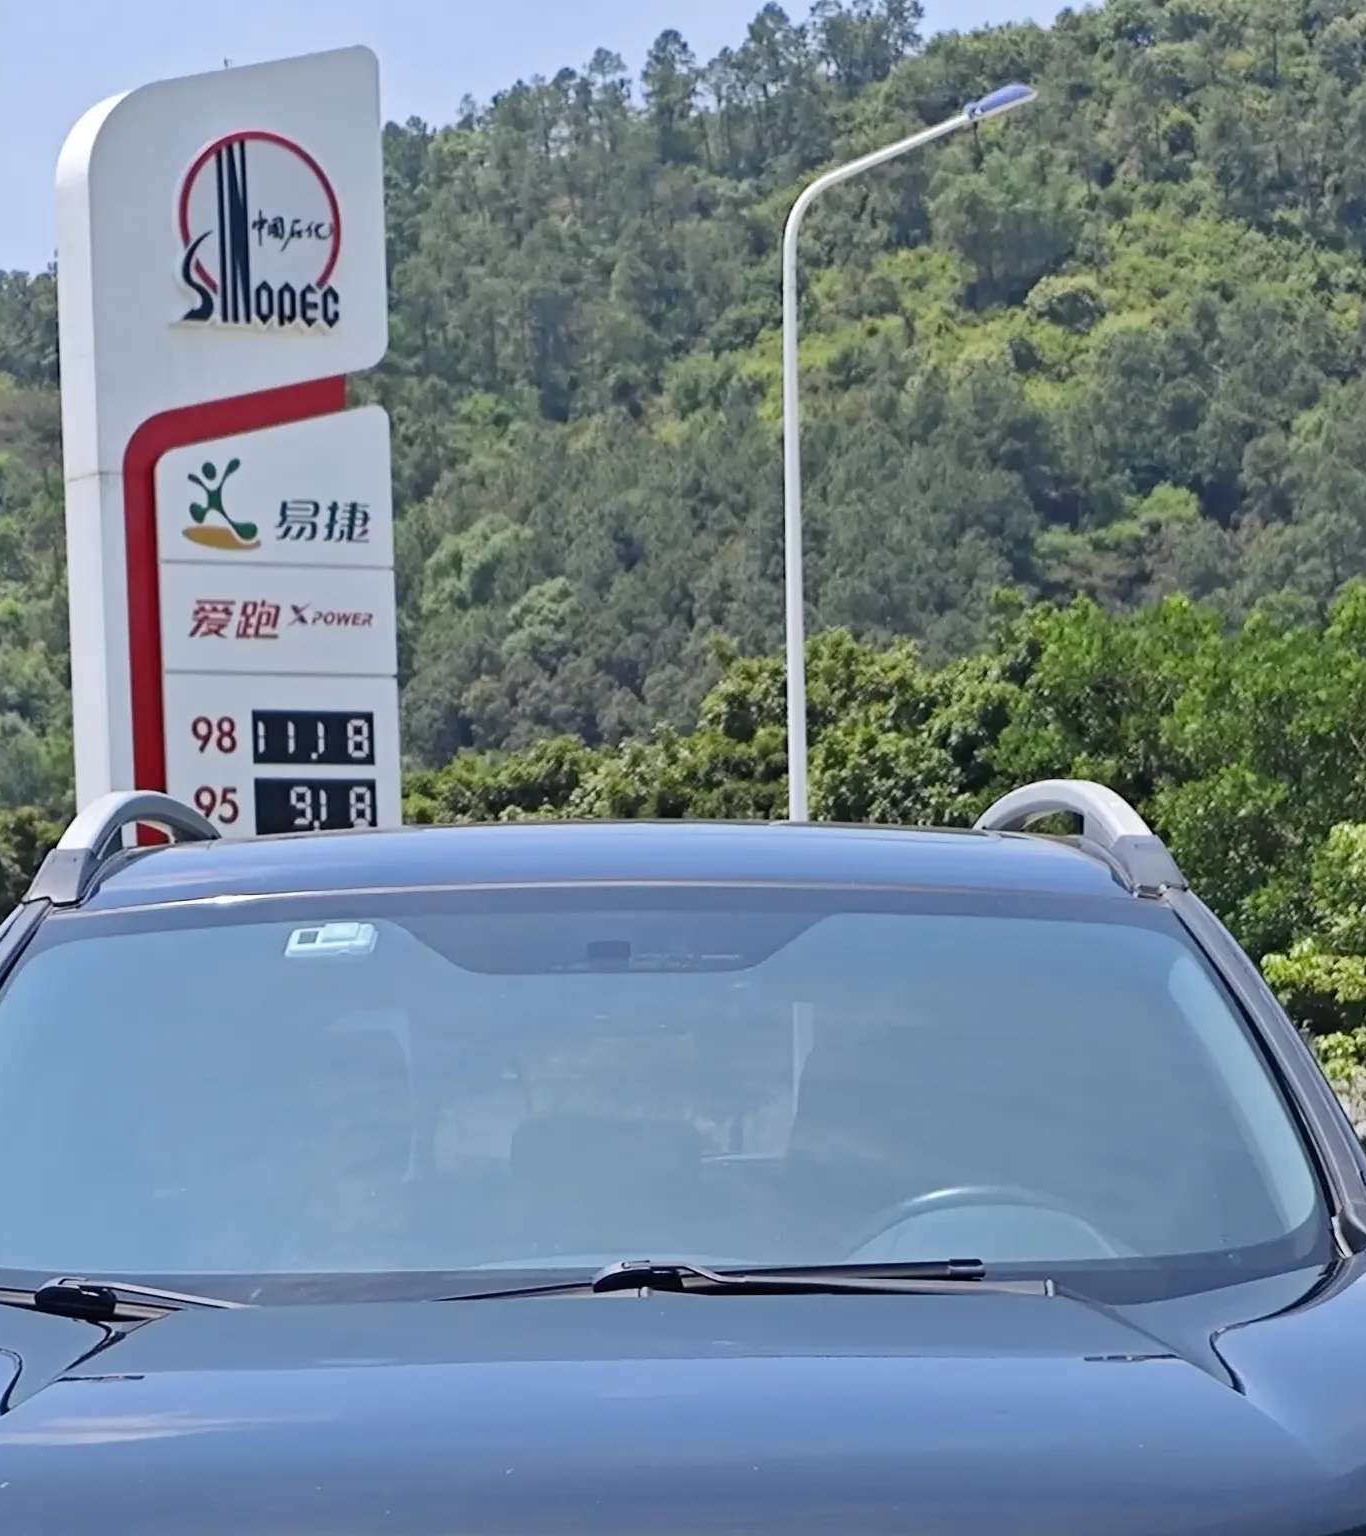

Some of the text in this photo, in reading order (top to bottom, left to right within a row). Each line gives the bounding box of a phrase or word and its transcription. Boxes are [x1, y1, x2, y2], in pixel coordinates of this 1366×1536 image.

[274, 500, 371, 544] 易捷
[188, 599, 281, 639] 爱跑
[191, 716, 370, 759] 98 11.18
[194, 786, 239, 824] 95
